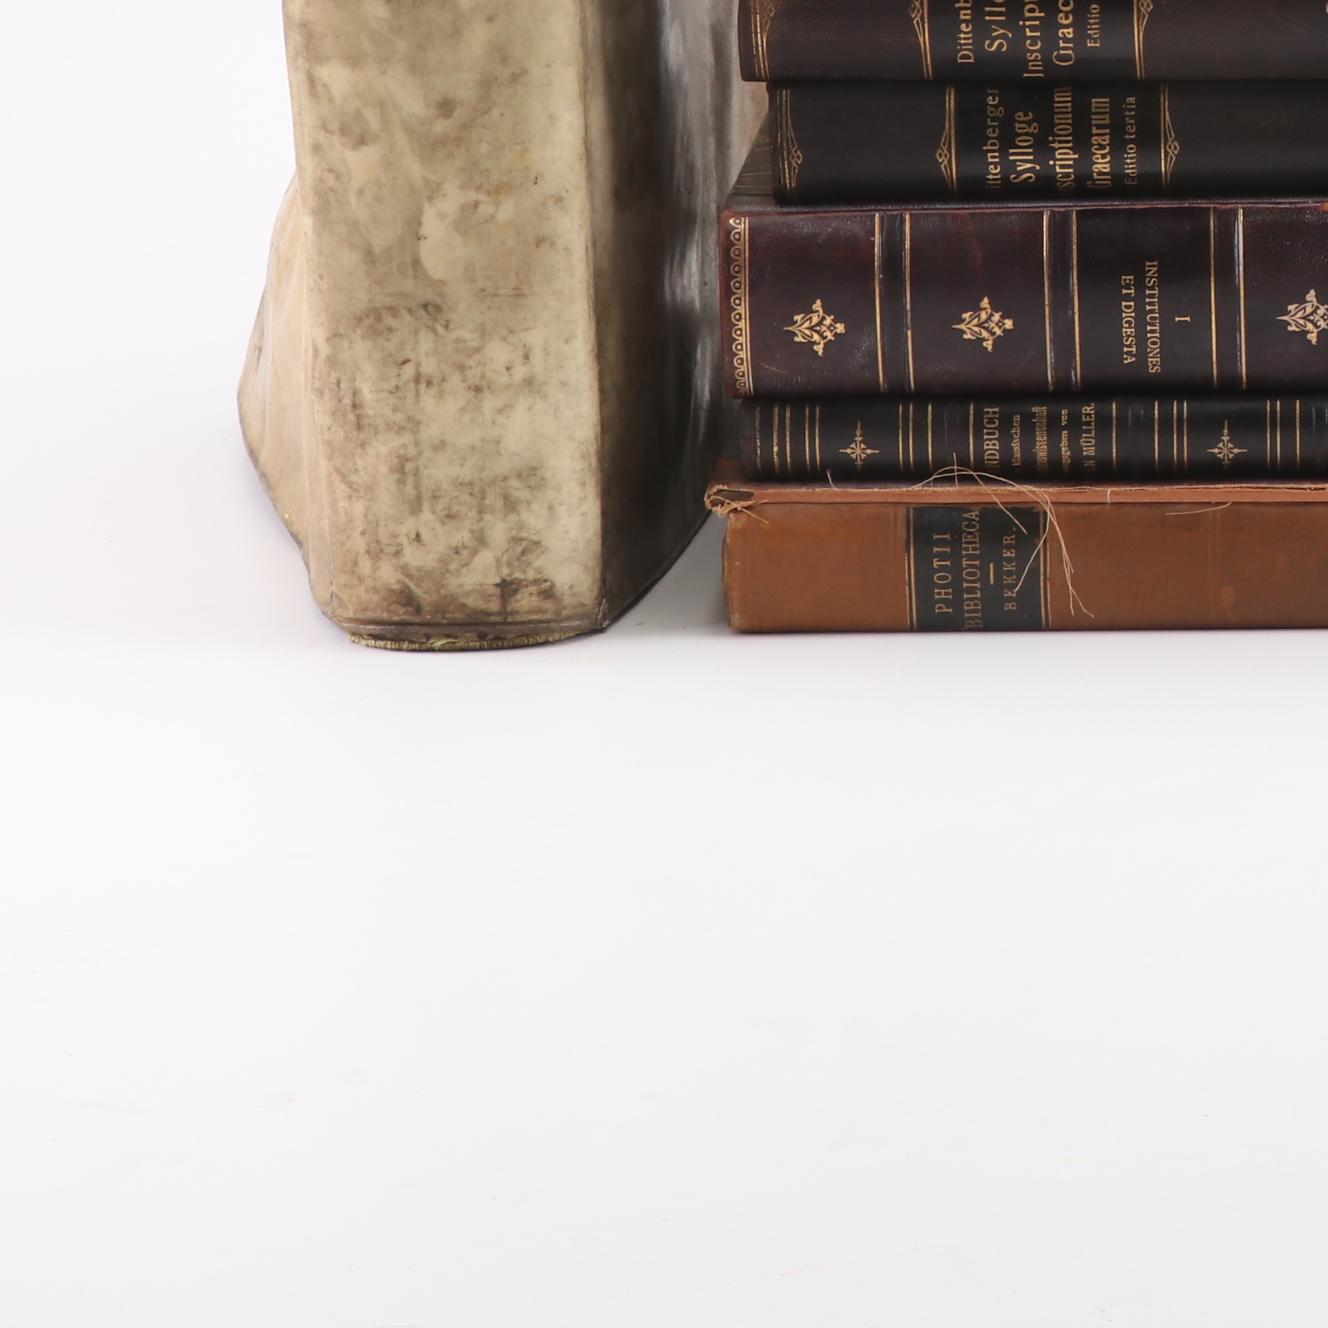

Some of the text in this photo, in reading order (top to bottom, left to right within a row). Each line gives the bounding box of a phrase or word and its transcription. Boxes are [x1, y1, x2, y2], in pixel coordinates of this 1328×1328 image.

[1086, 4, 1101, 49] Editio
[982, 88, 1005, 189] ittenberger
[1007, 111, 1041, 183] Sylloge
[1047, 86, 1080, 190] scriptionum
[1086, 96, 1112, 190] Graecarum
[1121, 96, 1139, 185] Editio tertia
[1121, 274, 1137, 365] ET DIGESTA
[1144, 260, 1161, 375] INSTITUTIONES
[1080, 402, 1096, 457] MÜLLER.
[932, 532, 953, 615] PHOTII
[961, 510, 983, 629] BIBLIOTHECA
[1003, 527, 1017, 611] BEKKER.
